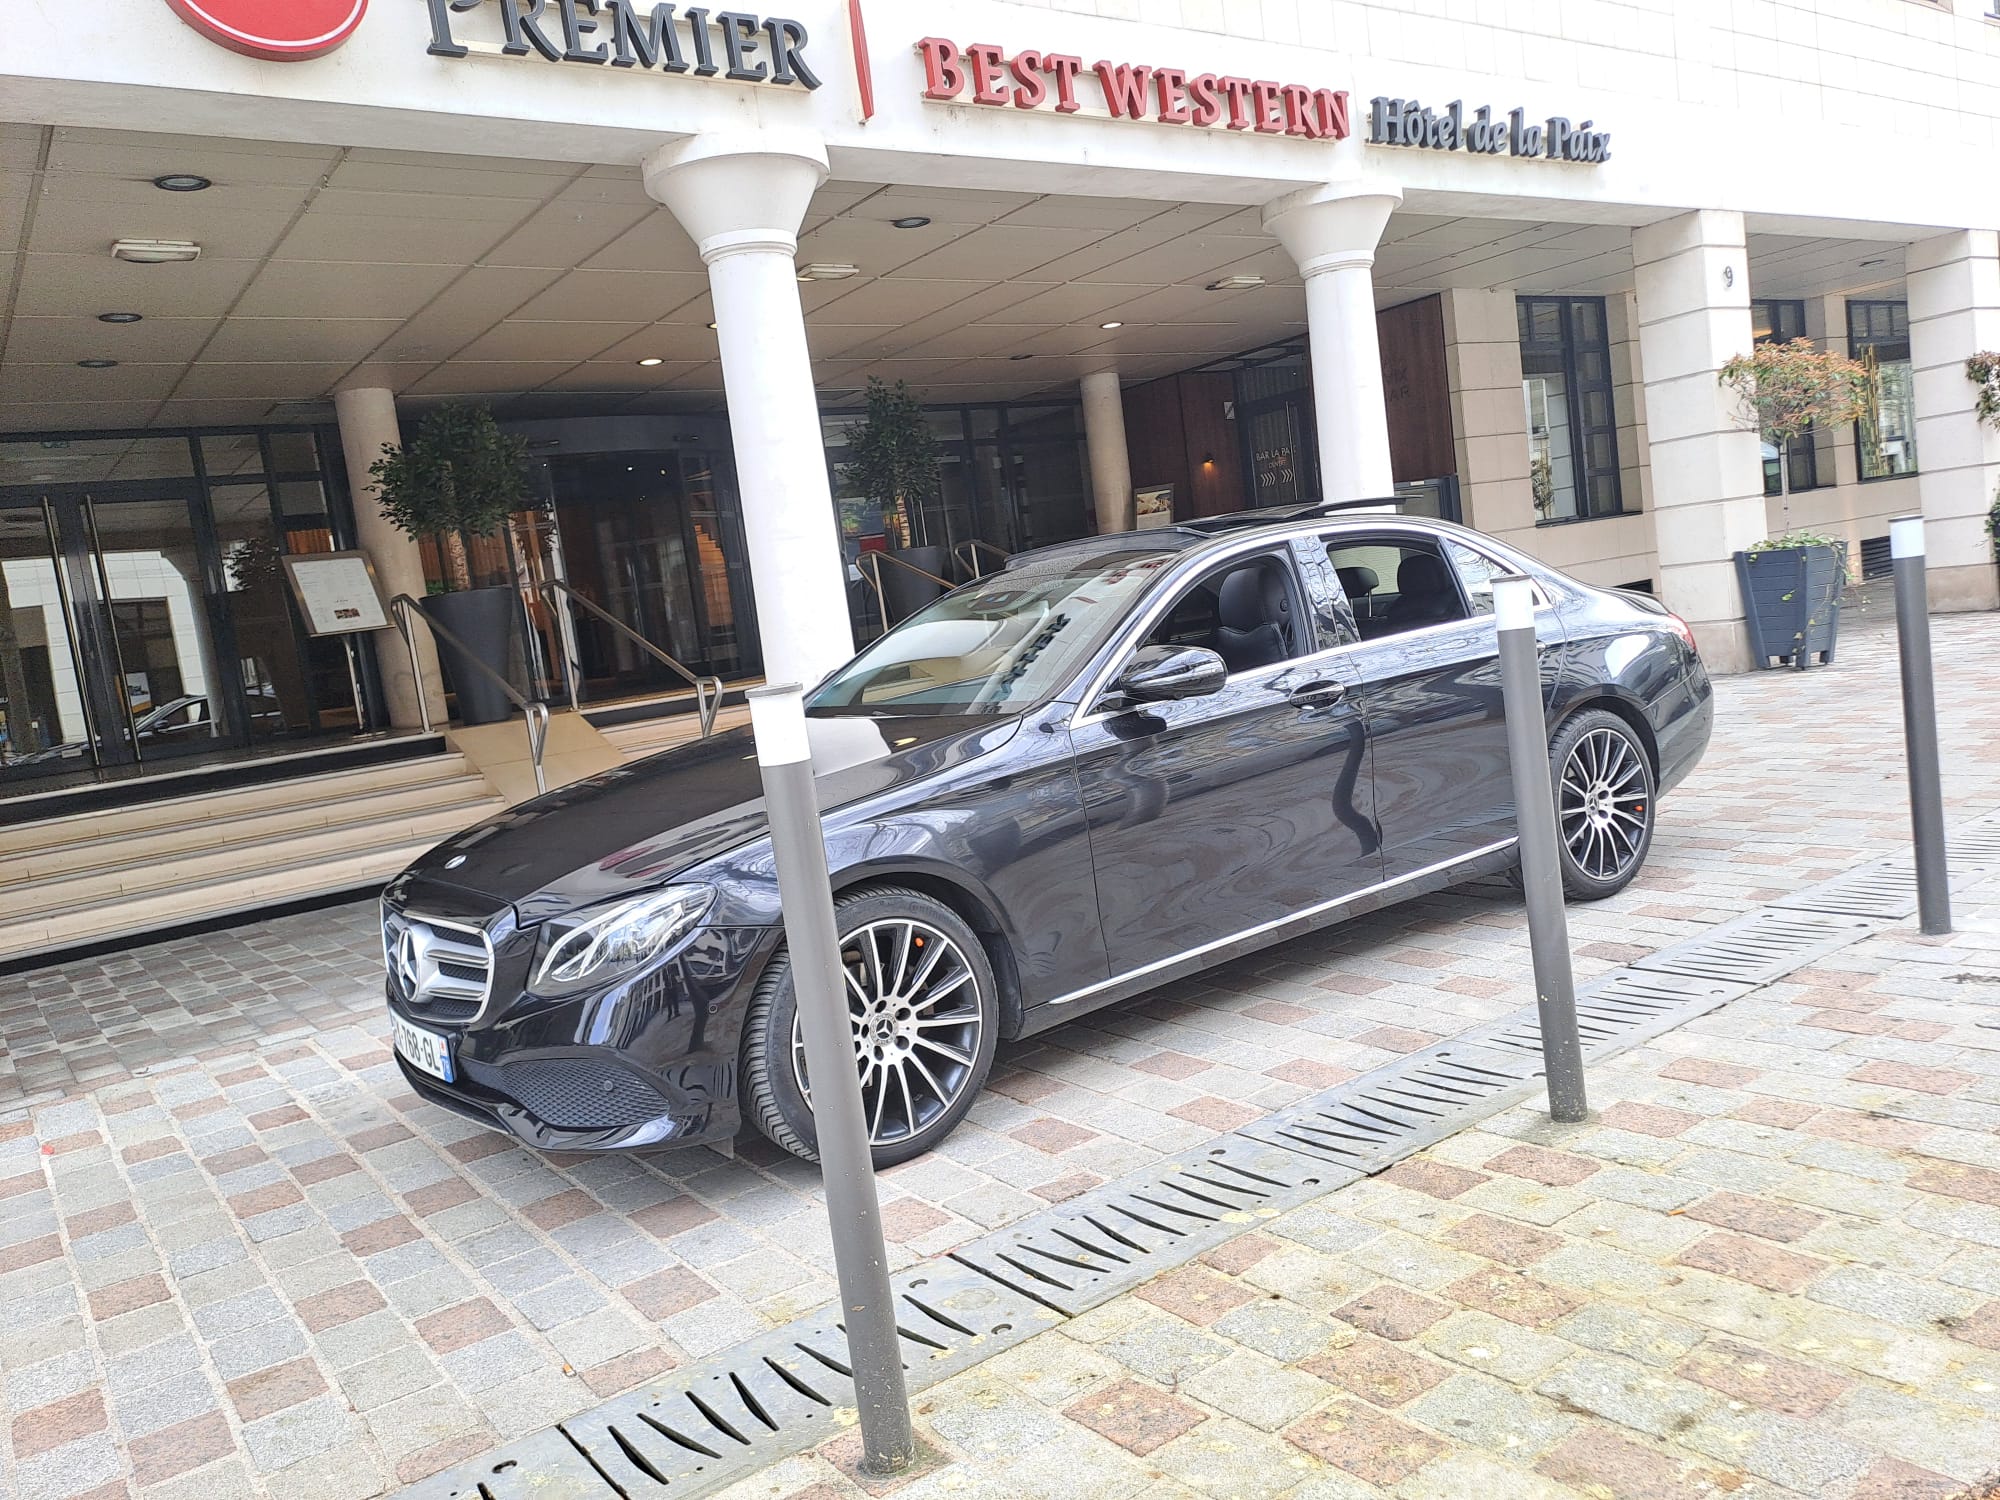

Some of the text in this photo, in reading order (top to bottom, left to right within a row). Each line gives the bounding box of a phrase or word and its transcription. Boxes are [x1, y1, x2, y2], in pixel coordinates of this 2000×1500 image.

[426, 0, 822, 90] PREMIER
[918, 36, 1350, 140] BEST WESTERN
[1370, 96, 1612, 163] Hôtel de la Paix
[1723, 265, 1733, 288] 9
[1256, 450, 1270, 462] BAR
[1270, 448, 1280, 458] LA
